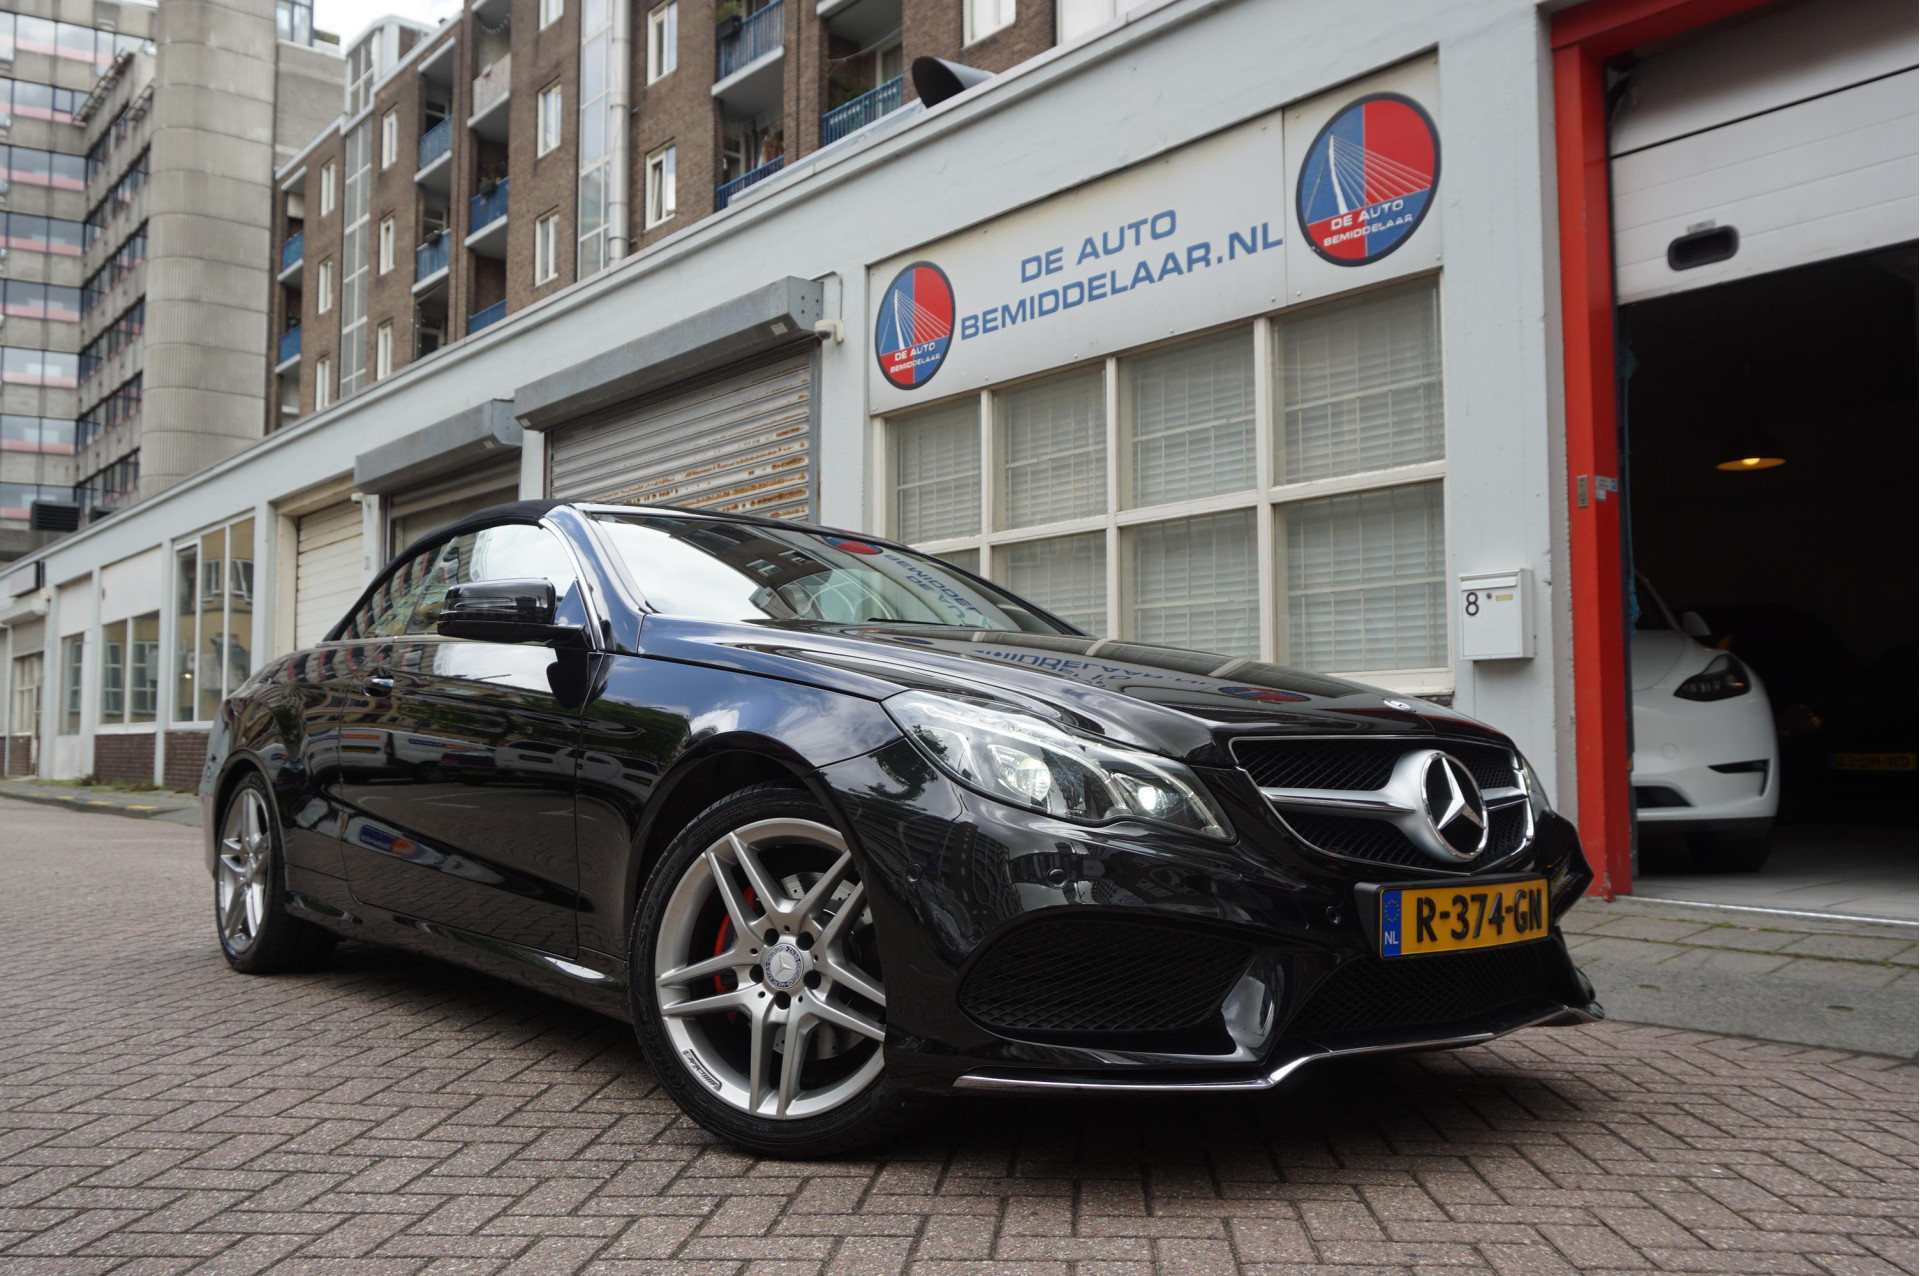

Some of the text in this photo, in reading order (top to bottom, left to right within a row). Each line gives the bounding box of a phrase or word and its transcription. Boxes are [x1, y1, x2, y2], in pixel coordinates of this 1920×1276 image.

[1323, 213, 1413, 247] BEMIDDELAAR
[1331, 199, 1404, 230] DE AUTO
[1020, 209, 1177, 284] DE AUTO
[960, 221, 1284, 341] BEMIDDELAAR.NL
[890, 353, 941, 373] BEMIDDELAAR
[894, 342, 936, 361] DE AUTO
[1465, 591, 1479, 616] 8
[1416, 888, 1543, 943] R-374-GN
[1384, 931, 1399, 945] NL
